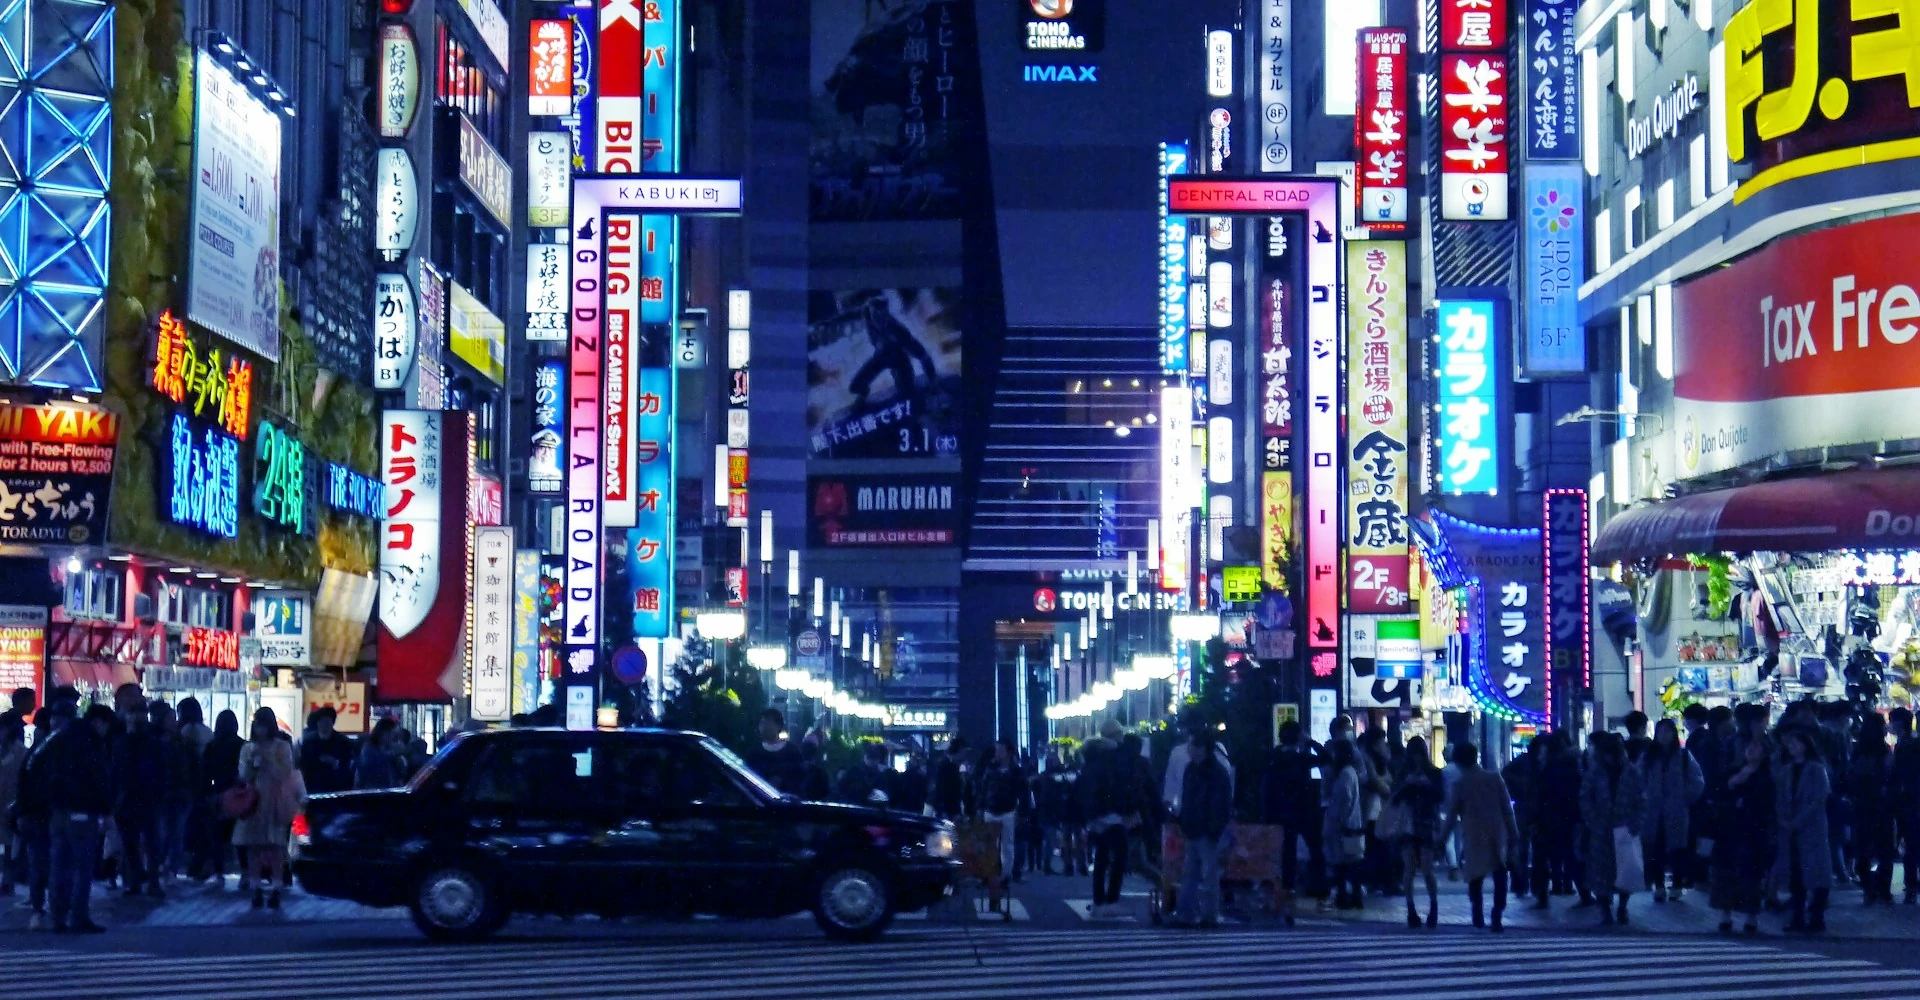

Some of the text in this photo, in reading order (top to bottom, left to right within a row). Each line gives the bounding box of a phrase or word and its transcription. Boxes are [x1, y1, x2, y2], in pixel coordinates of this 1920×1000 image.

[1027, 21, 1070, 35] TOHO
[1027, 36, 1085, 48] CINEMAS
[1024, 65, 1097, 81] IMAX
[1214, 44, 1227, 89] 東京ビル
[1376, 56, 1394, 108] 居楽屋
[1628, 71, 1698, 160] Don Quijote
[1178, 190, 1310, 201] CENTRAL ROAD
[538, 208, 561, 223] 3F
[1539, 240, 1556, 306] STAGE
[1556, 240, 1571, 293] IDOL
[379, 283, 404, 293] 新宿
[1166, 222, 1187, 365] カラオケランド
[607, 313, 623, 342] BIC
[1363, 249, 1390, 393] きんくら酒場
[1760, 295, 1818, 368] Tax
[1540, 327, 1570, 347] 5F
[380, 369, 401, 381] B1
[1262, 346, 1291, 427] 甘太郎
[535, 366, 557, 426] 海の家
[1366, 395, 1387, 406] KIN
[1371, 404, 1385, 412] no
[1445, 306, 1491, 486] カラオケ
[35, 406, 117, 440] YAKI
[571, 249, 597, 602] GODZILLA ROAD
[1364, 412, 1392, 423] KURA
[899, 428, 930, 452] 3.1
[1266, 437, 1289, 452] 4F
[1312, 283, 1334, 581] ゴジラロード
[1701, 426, 1748, 456] Don Quijote
[1, 442, 113, 462] with Free-Flowing
[19, 458, 28, 471] 2
[31, 458, 68, 473] hours
[420, 414, 439, 490] 大衆酒場
[1266, 452, 1289, 467] 3F
[387, 423, 417, 551] トラノコ
[857, 486, 953, 511] MARUHAN
[1352, 430, 1408, 548] 金の蔵
[1, 525, 66, 540] TORADYU
[1, 640, 31, 652] YAKI
[1500, 581, 1532, 699] カラオケ
[480, 655, 503, 678] 集
